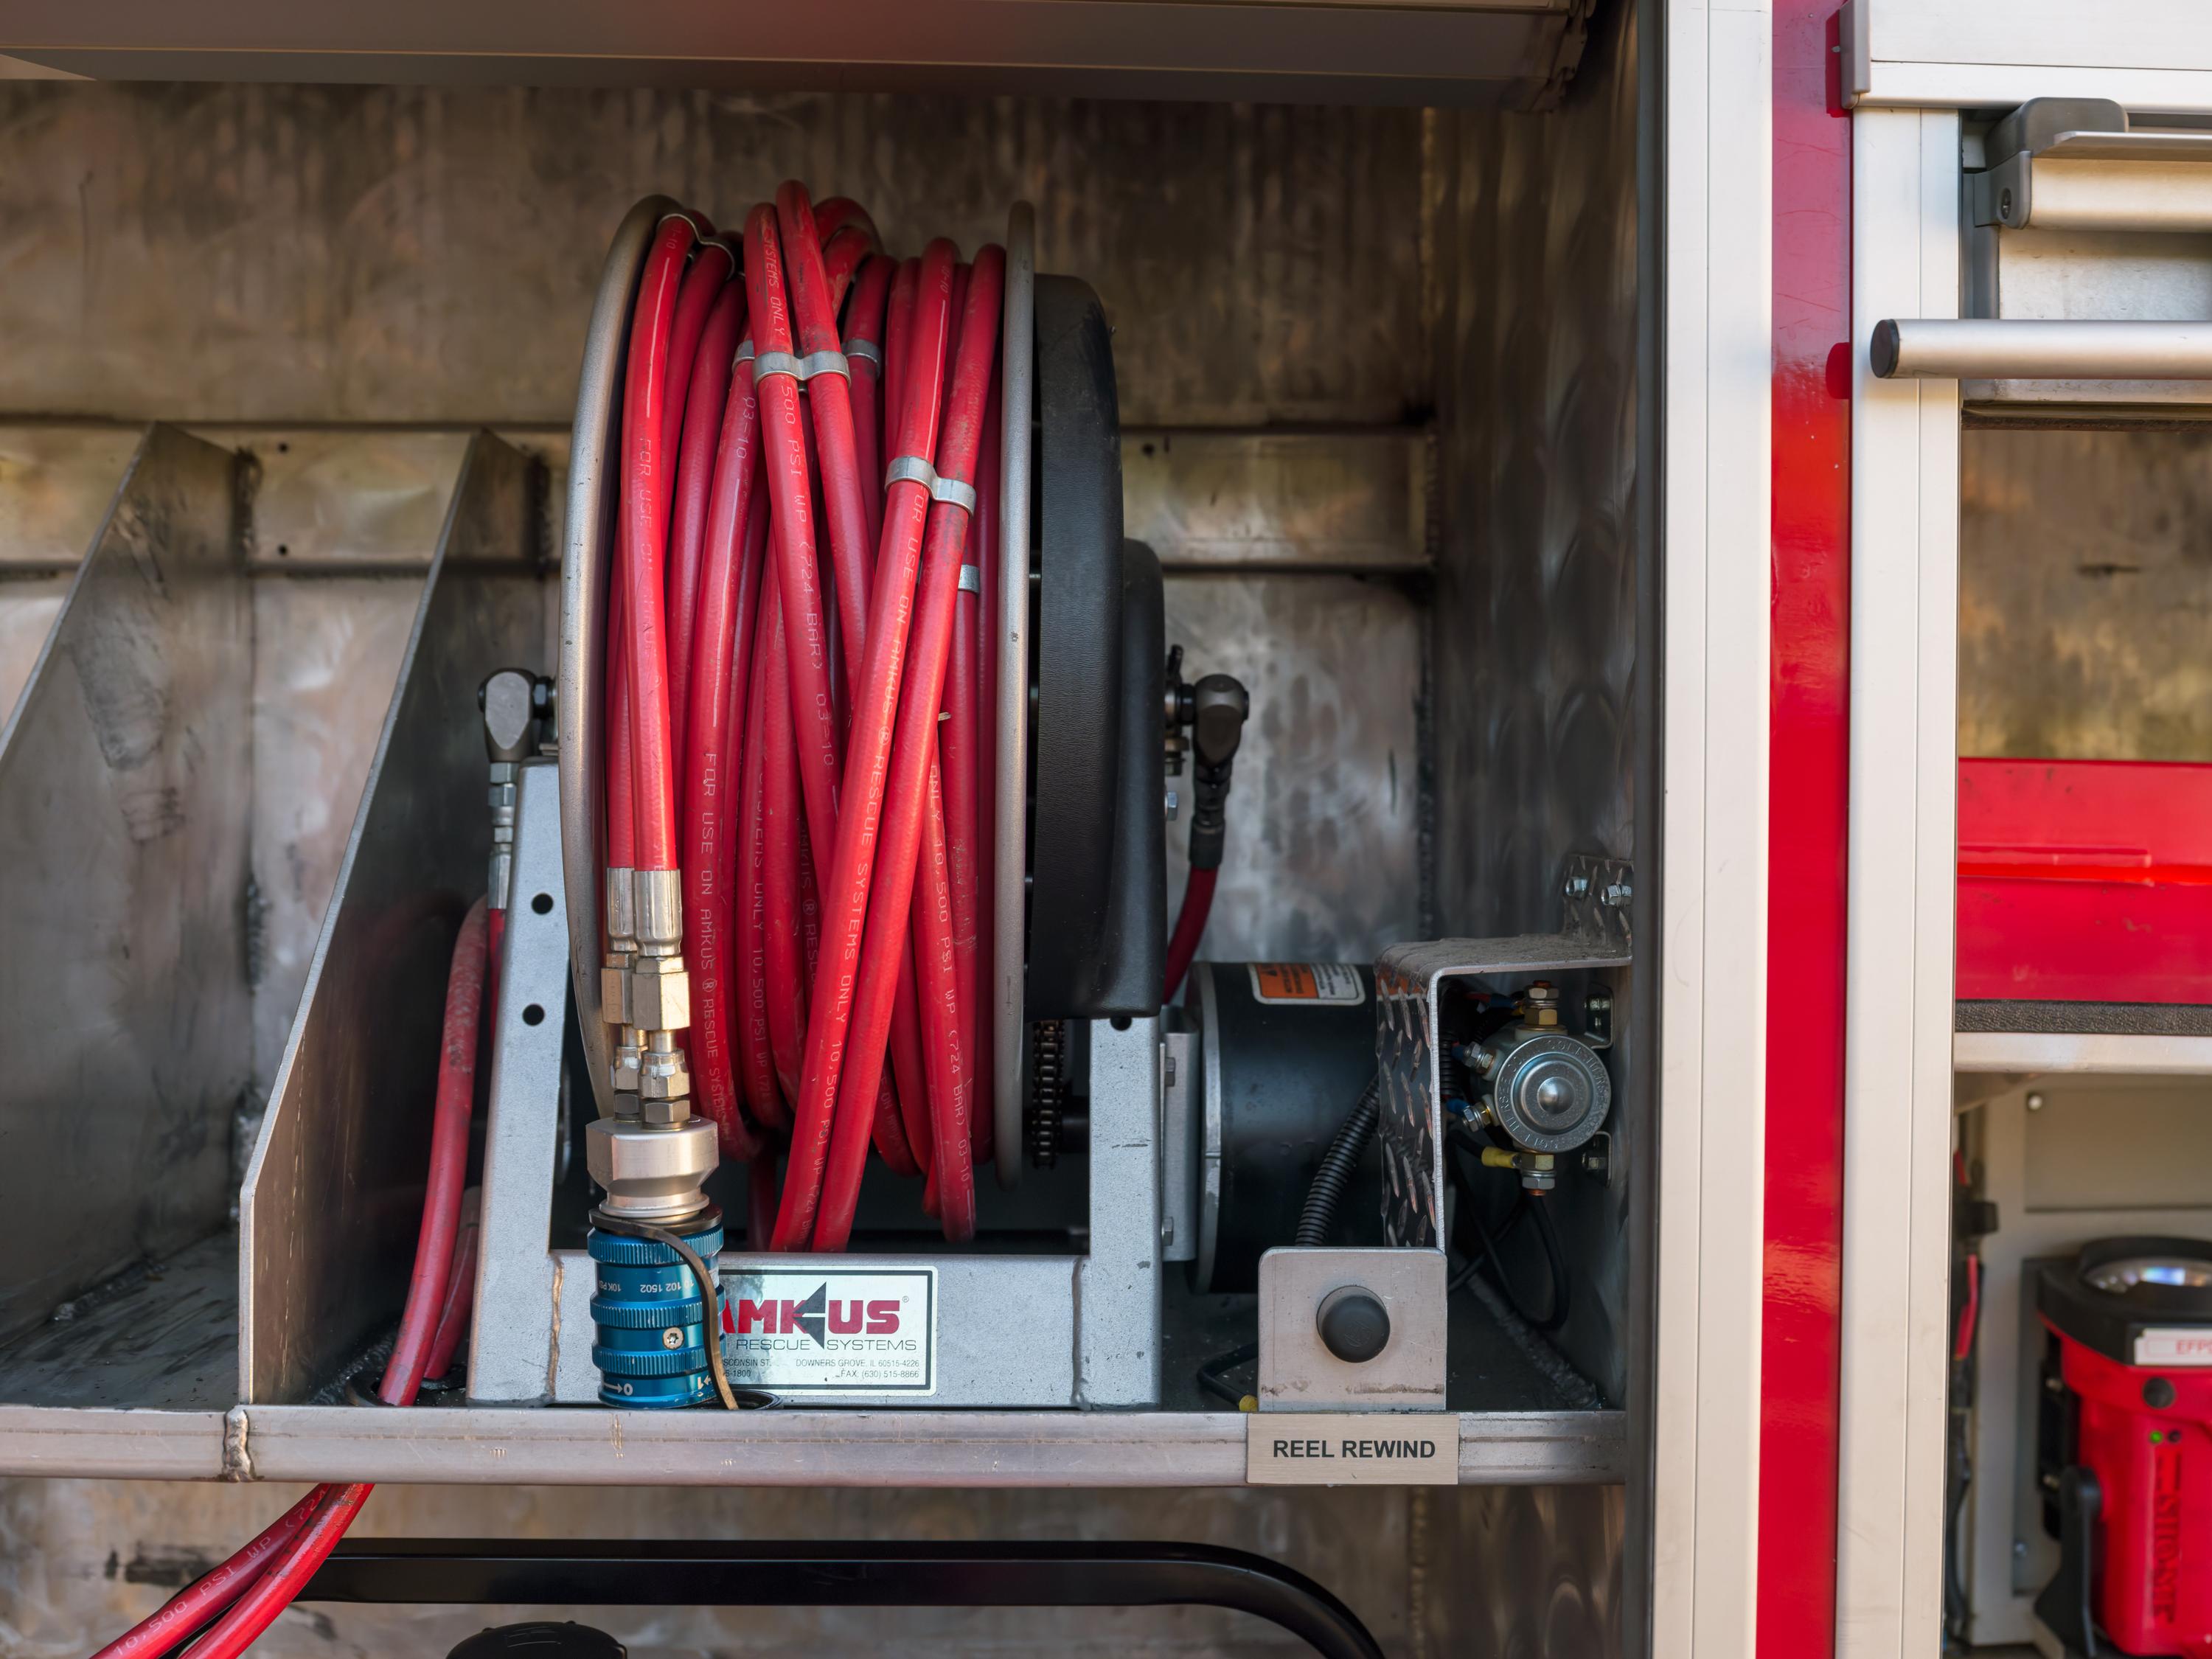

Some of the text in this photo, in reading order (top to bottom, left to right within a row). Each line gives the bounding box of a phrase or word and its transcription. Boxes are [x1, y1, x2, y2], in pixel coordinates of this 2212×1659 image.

[770, 296, 785, 336] ONLY
[779, 374, 796, 425] ,500
[737, 396, 756, 460] 03-10
[787, 439, 802, 476] PSI
[640, 489, 653, 529] USE
[794, 494, 807, 524] WP
[903, 536, 919, 582] USE
[897, 595, 910, 624] ON
[807, 612, 823, 669] BAR)
[883, 639, 902, 715] AMKUS
[815, 693, 835, 766] 03-10
[704, 753, 717, 796] FOR
[861, 755, 886, 846] RESCUE
[701, 812, 714, 855] USE
[701, 870, 713, 895] ON
[844, 863, 869, 961] SYSTEMS
[700, 908, 715, 970] AMKUS
[940, 936, 953, 973] PSI
[753, 949, 765, 1009] 10,500
[835, 974, 852, 1023] ONLY
[945, 989, 956, 1015] WP
[702, 998, 719, 1059] RESCUE
[948, 1029, 961, 1074] (724
[824, 1040, 842, 1109] 10,500
[953, 1084, 965, 1127] BAR)
[818, 1119, 831, 1145] PSI
[608, 1281, 622, 1293] 10K
[640, 1284, 663, 1293] 1502
[666, 1281, 682, 1291] 102
[723, 1358, 758, 1367] SCONSIN
[796, 1358, 836, 1367] DOWNERS
[870, 1359, 876, 1367] IL
[878, 1359, 919, 1367] 60515-4226
[736, 1339, 917, 1351] RESCUE SYSTEMS
[725, 1369, 751, 1377] 5-1800
[861, 1370, 881, 1380] (630)
[883, 1370, 919, 1378] 515-8866
[1273, 1440, 1436, 1458] REEL REWIND
[113, 1600, 189, 1657] 10,500
[198, 1564, 237, 1597] PSI
[247, 1536, 272, 1559] WP
